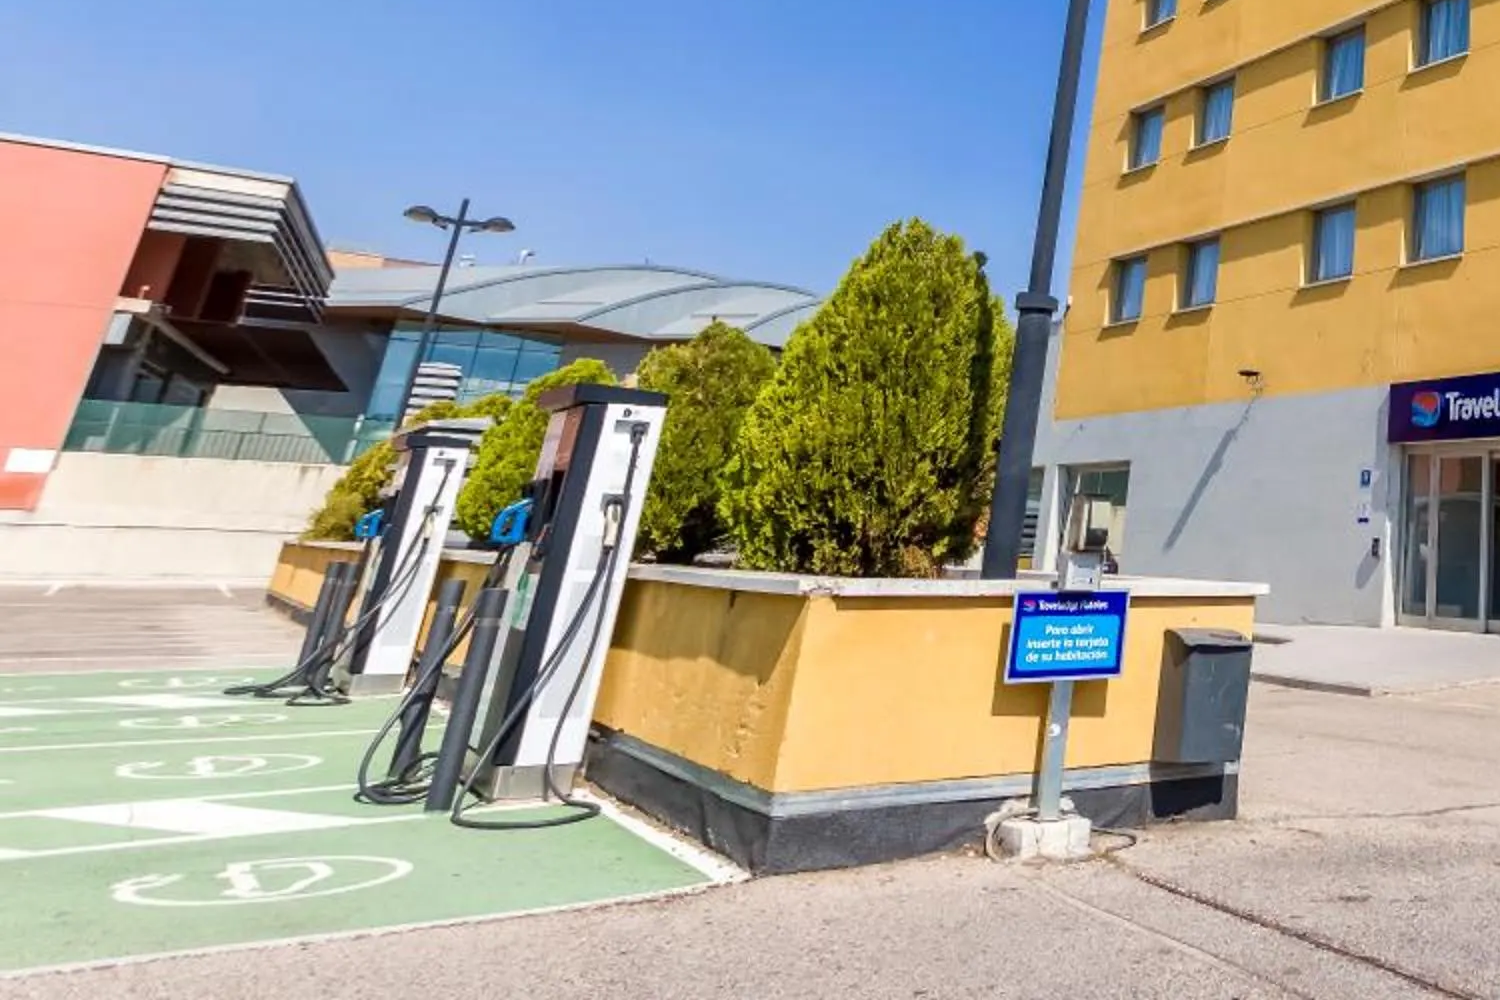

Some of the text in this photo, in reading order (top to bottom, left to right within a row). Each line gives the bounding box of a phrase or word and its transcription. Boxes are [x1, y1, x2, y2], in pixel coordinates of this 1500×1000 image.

[1045, 624, 1094, 634] Para abrir
[1026, 637, 1108, 649] inserte la tarjeta
[1026, 652, 1039, 663] de
